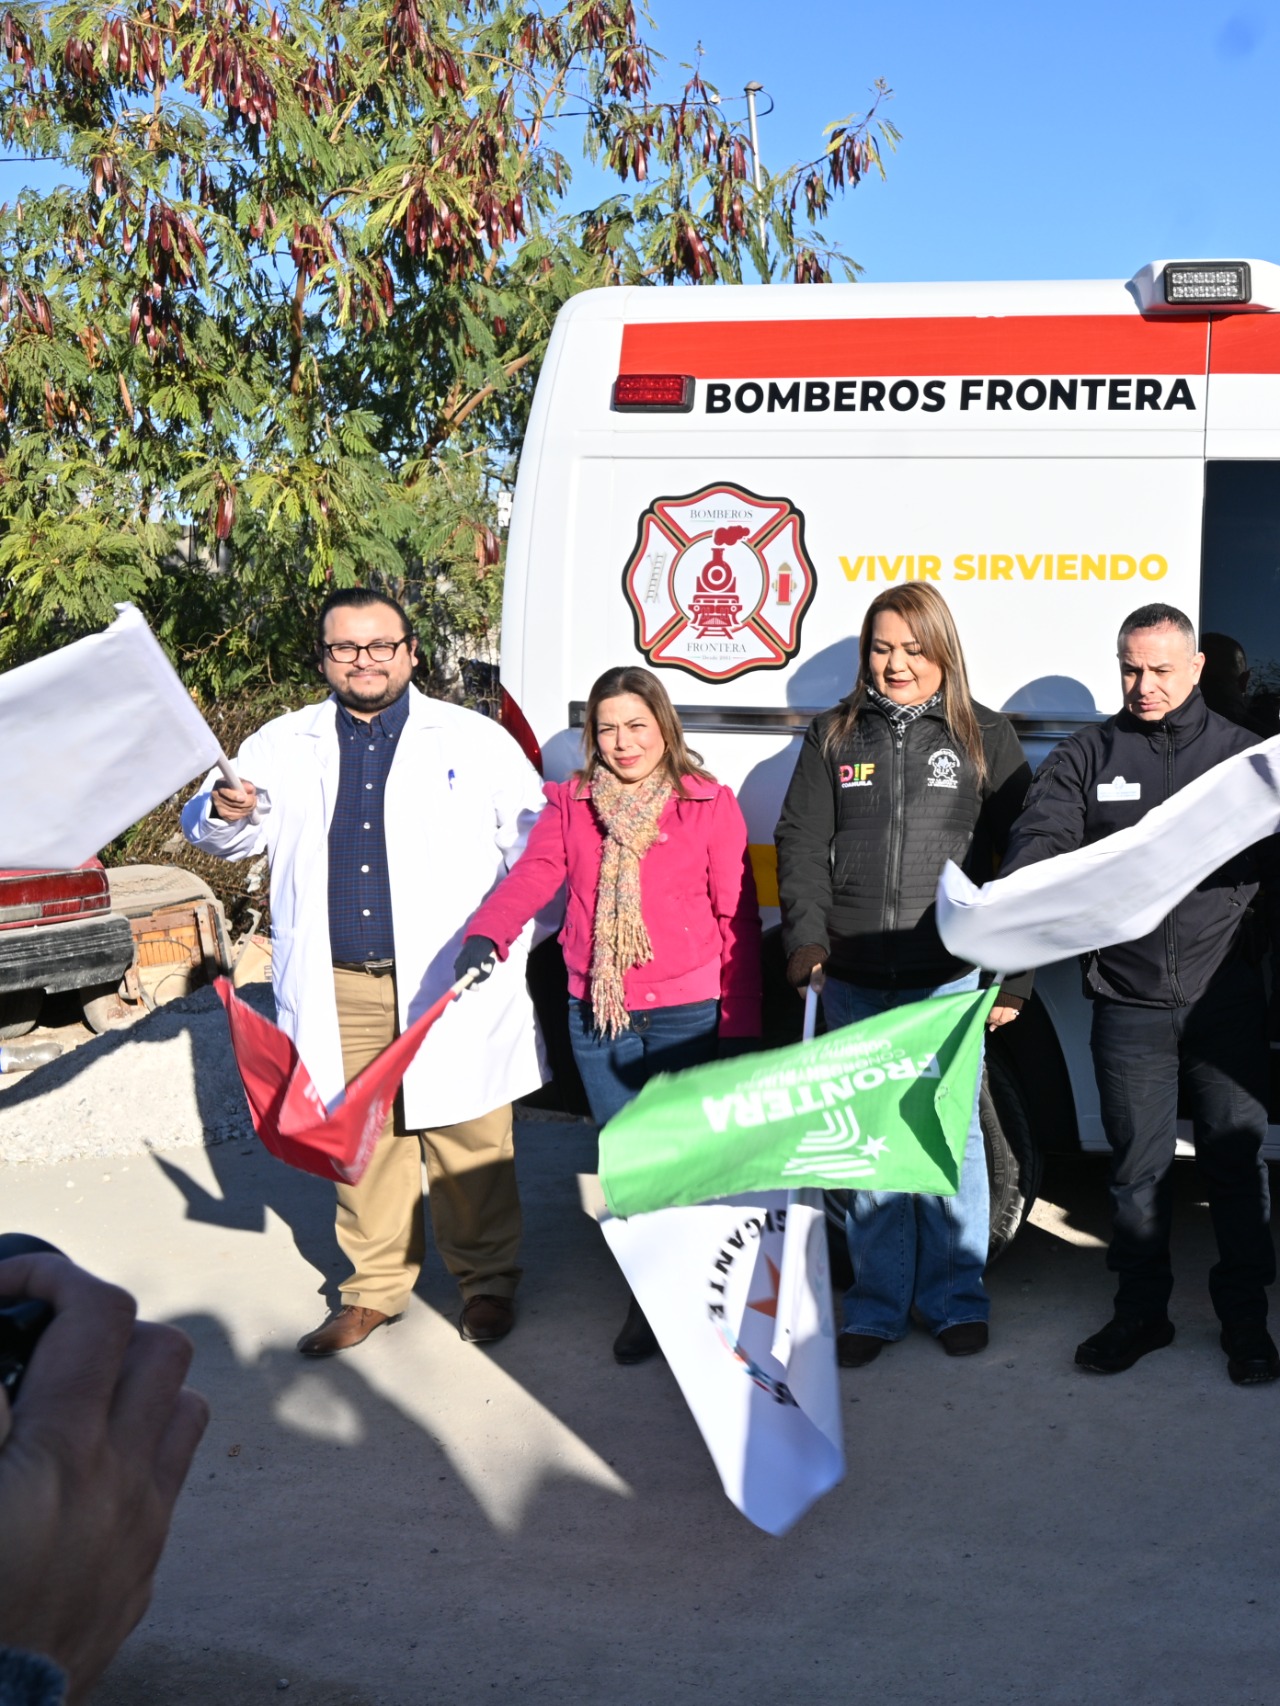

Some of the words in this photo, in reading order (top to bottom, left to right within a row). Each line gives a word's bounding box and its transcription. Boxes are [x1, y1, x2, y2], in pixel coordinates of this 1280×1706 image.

[705, 379, 947, 414] BOMBEROS
[959, 378, 1197, 411] FRONTERA
[690, 509, 753, 519] BOMBEROS
[838, 555, 942, 582] VIVIR
[953, 553, 1169, 581] SIRVIENDO
[687, 642, 747, 653] FRONTERA
[839, 763, 875, 783] DIF
[701, 1053, 941, 1133] FRONTERA
